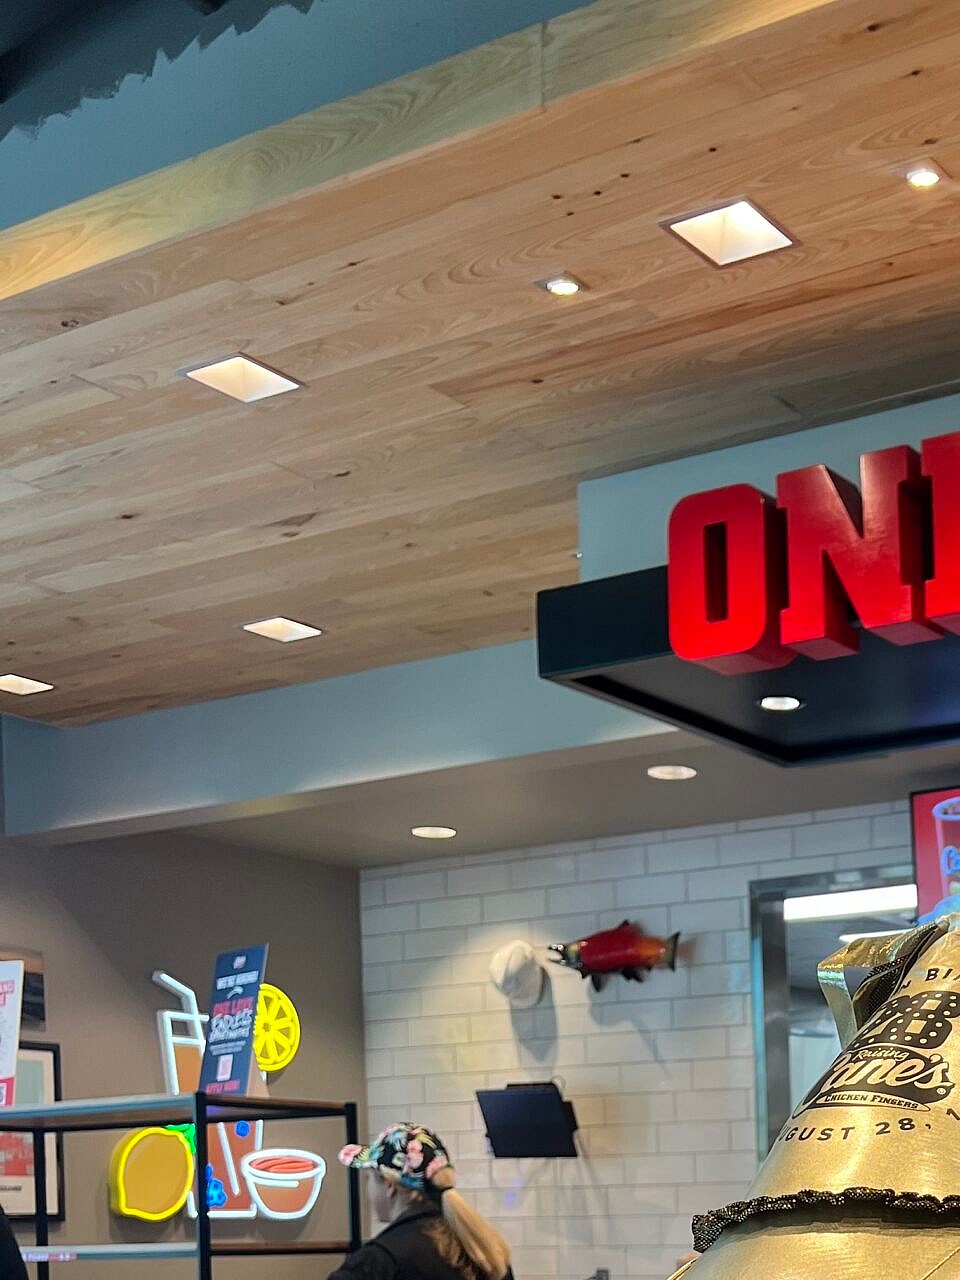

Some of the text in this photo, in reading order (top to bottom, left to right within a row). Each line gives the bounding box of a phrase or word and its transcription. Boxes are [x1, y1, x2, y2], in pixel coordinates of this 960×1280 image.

[855, 1047, 909, 1060] Raising
[824, 1093, 918, 1110] CHICKEN FINGERS
[876, 1118, 931, 1135] 28,
